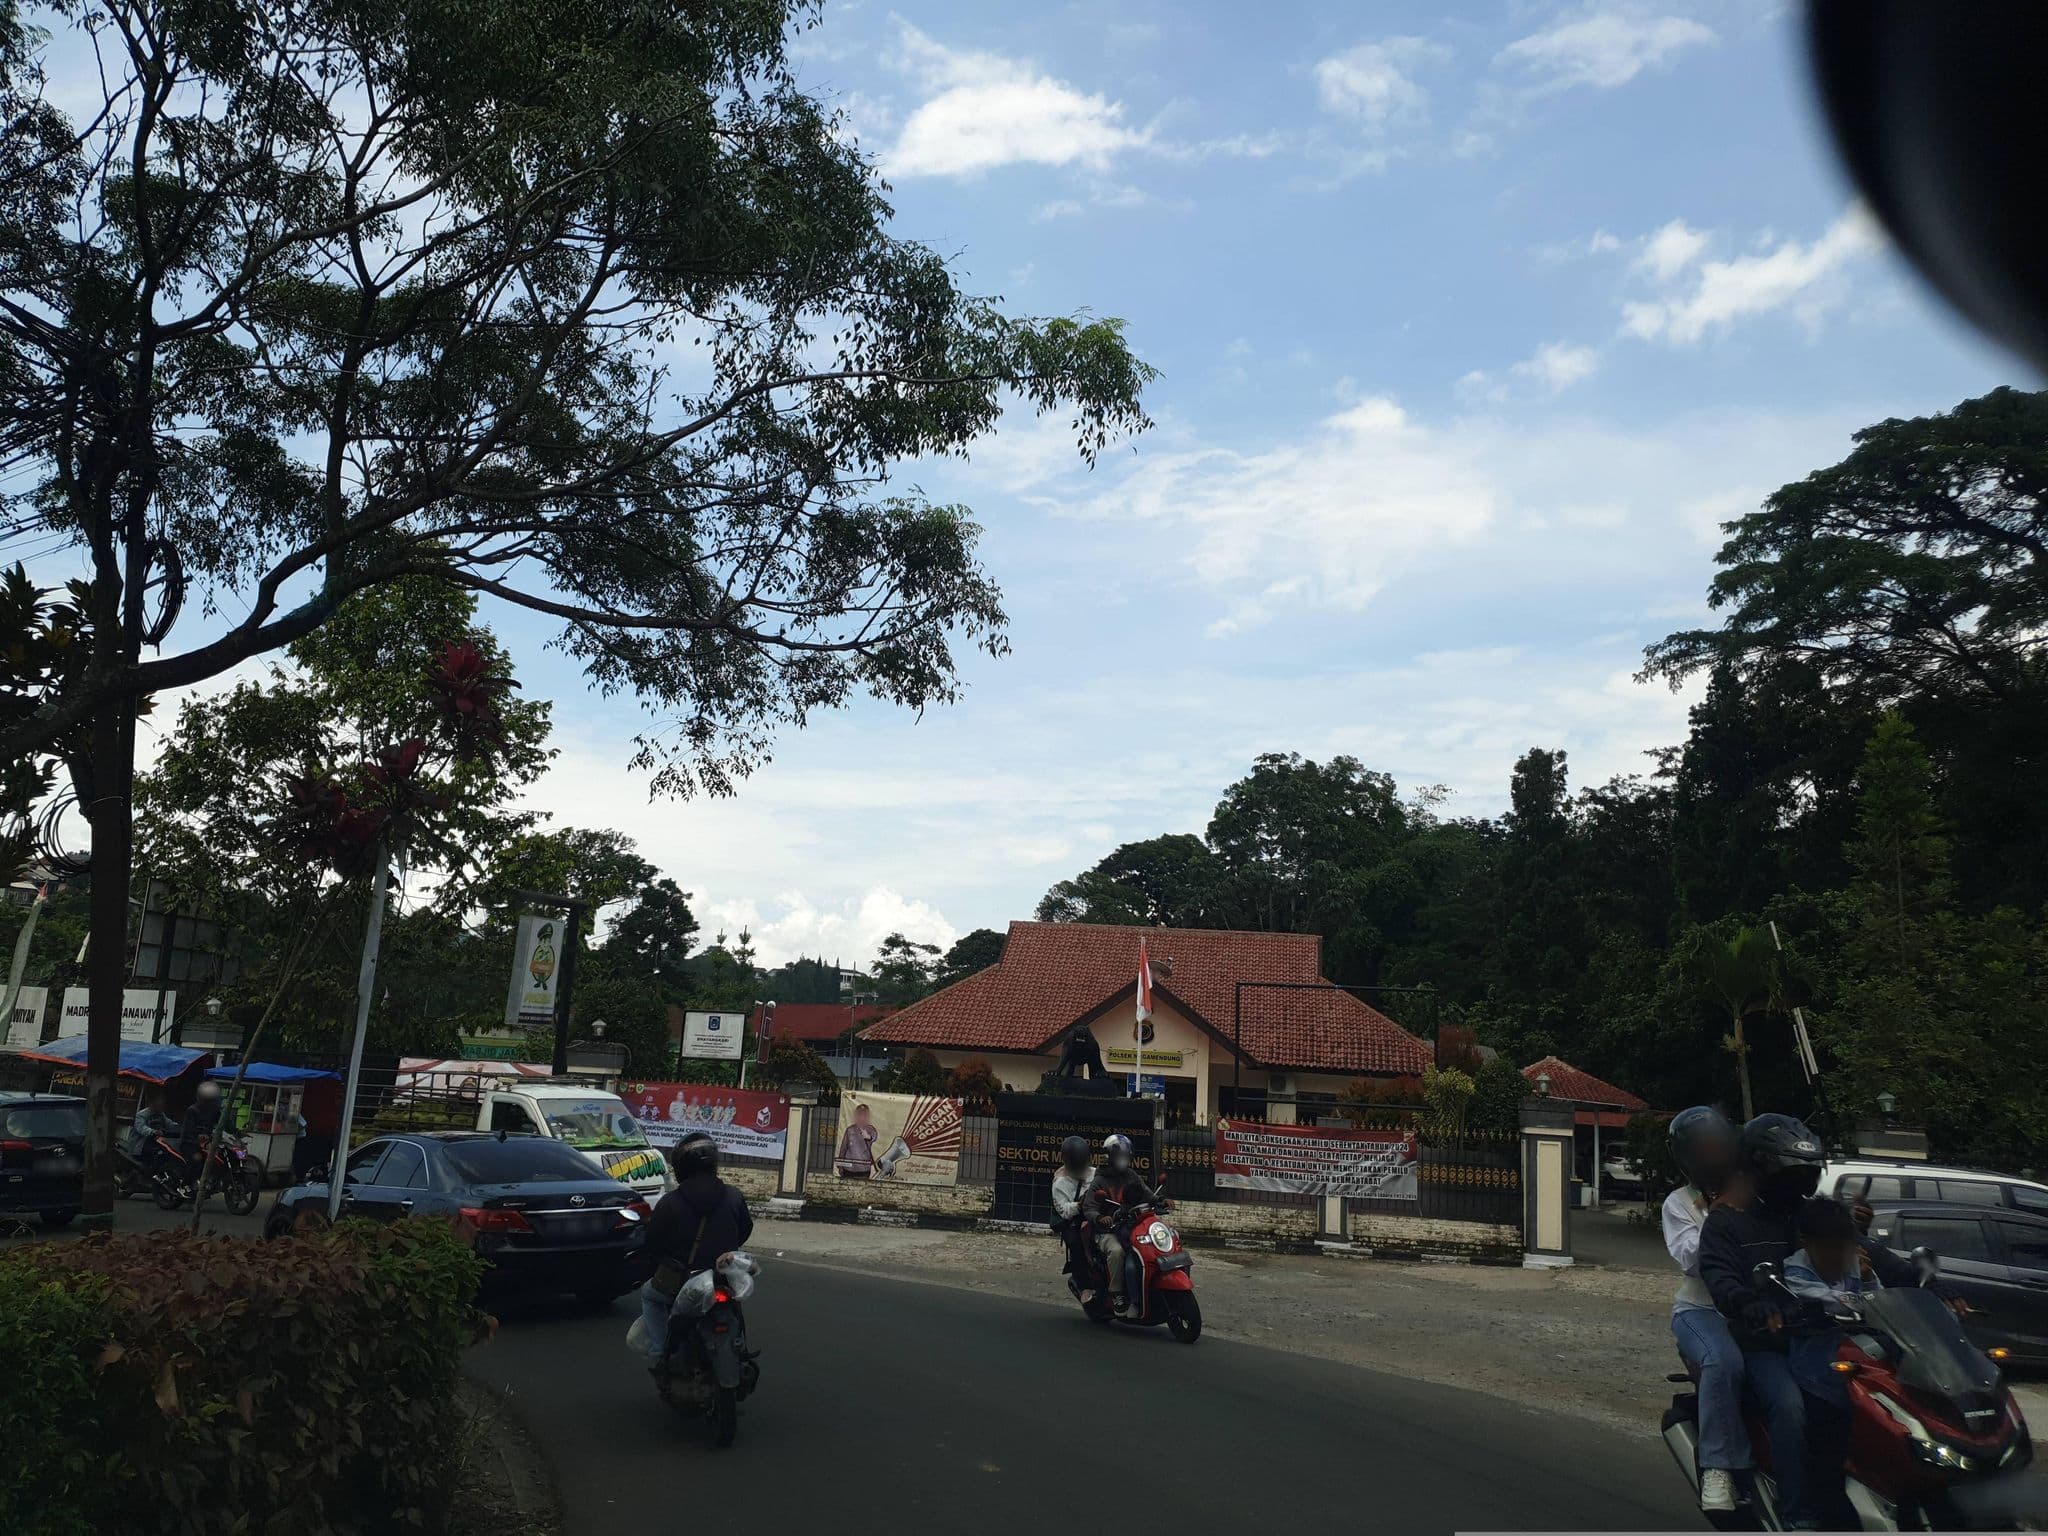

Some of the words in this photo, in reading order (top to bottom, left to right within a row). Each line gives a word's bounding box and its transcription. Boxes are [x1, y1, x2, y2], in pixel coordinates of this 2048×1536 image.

[913, 1101, 954, 1138] JANGAN
[918, 1110, 958, 1140] GOLPUT
[1043, 1121, 1074, 1132] NEGARA
[1077, 1124, 1112, 1135] REPUBLIK
[1113, 1126, 1151, 1137] INDONESIA
[1225, 1131, 1243, 1141] MARI
[1244, 1133, 1260, 1142] KITA
[1261, 1134, 1302, 1145] SUKSESKAN
[1303, 1138, 1329, 1148] PEMILU
[1330, 1140, 1366, 1150] SERENTAK
[1366, 1142, 1389, 1151] TAHUN
[1390, 1142, 1409, 1152] 2024
[998, 1146, 1049, 1162] SEKTOR
[1238, 1144, 1255, 1154] YANG
[1256, 1146, 1278, 1156] AMAN
[1278, 1148, 1293, 1157] DAN
[1293, 1149, 1318, 1159] DAMAI
[1318, 1151, 1341, 1160] SERTA
[1341, 1153, 1362, 1162] TETAP
[1363, 1154, 1396, 1163] MENJAGA
[1224, 1154, 1264, 1166] PERSATUAN
[1264, 1159, 1270, 1167] &
[1271, 1159, 1307, 1170] KESATUAN
[1307, 1162, 1332, 1171] UNTUK
[1333, 1163, 1382, 1175] MENCIPTAKAN
[1383, 1166, 1410, 1176] PEMILU
[1250, 1168, 1269, 1178] YANG
[1270, 1170, 1315, 1182] DEMOKRATIS
[1315, 1174, 1331, 1183] DAN
[1331, 1175, 1383, 1186] BERMARTABAT
